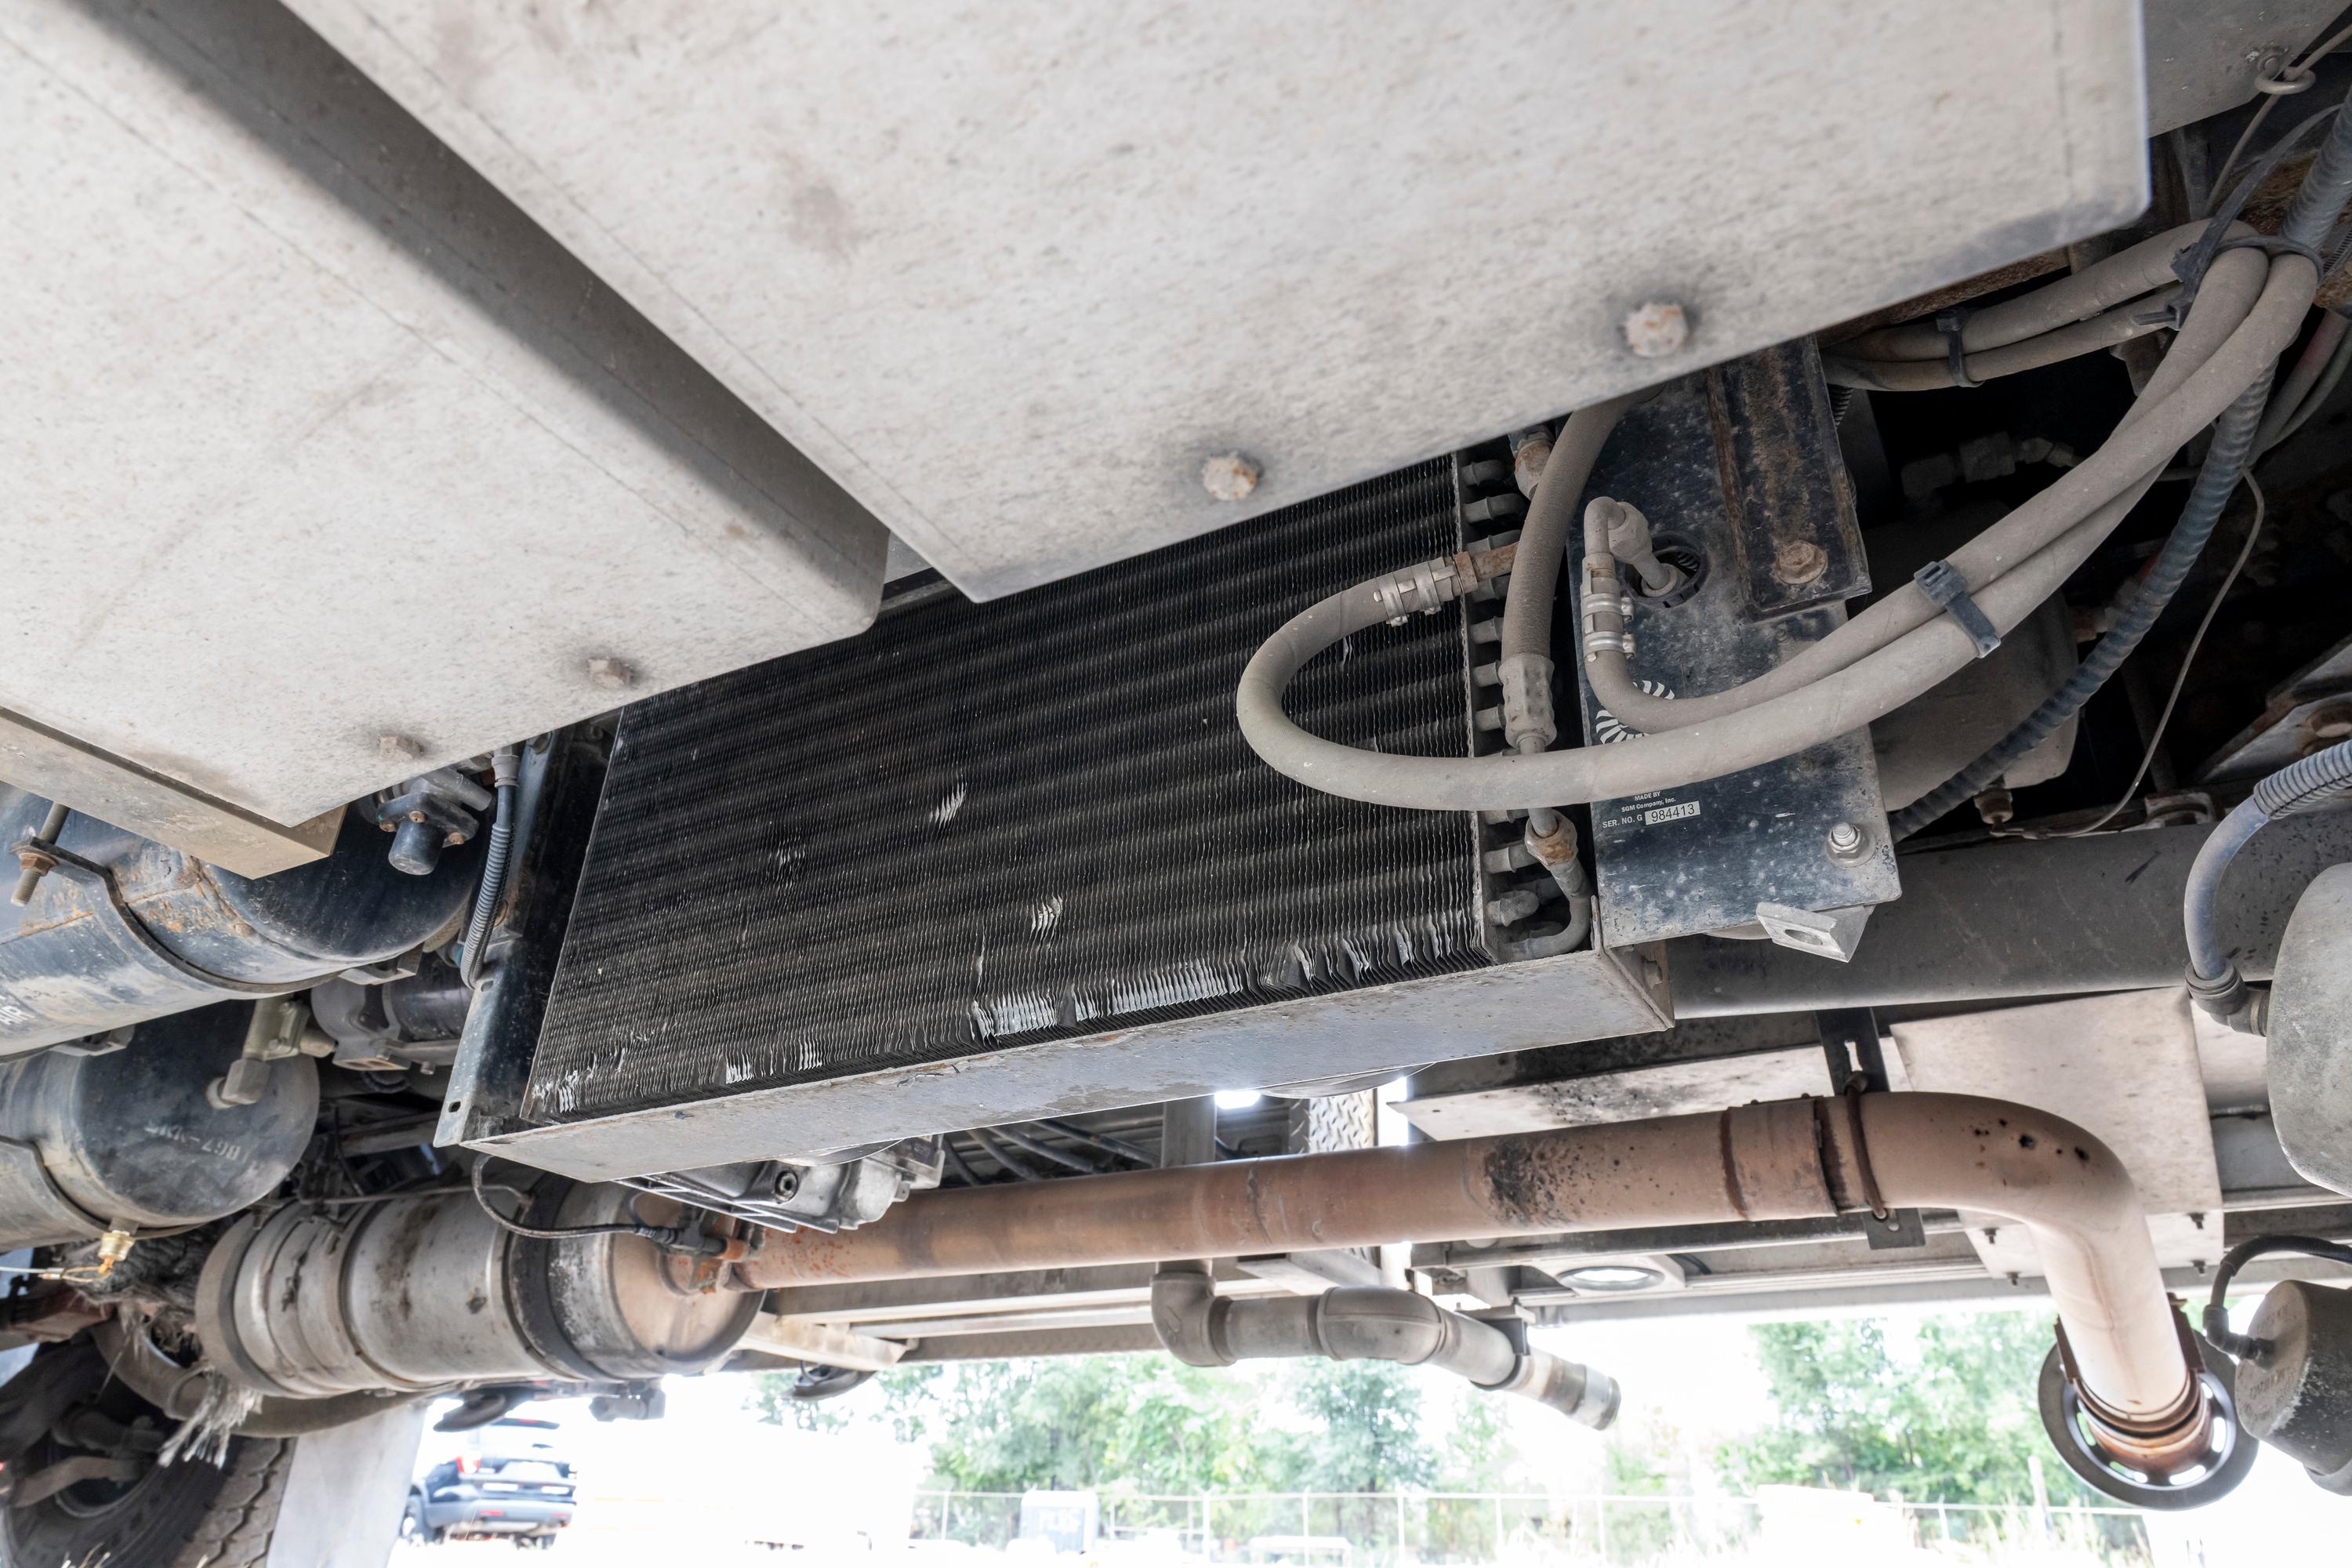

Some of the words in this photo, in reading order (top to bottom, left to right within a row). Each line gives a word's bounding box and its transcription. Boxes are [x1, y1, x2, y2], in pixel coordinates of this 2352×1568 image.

[1635, 793, 1652, 801] MADE
[1636, 800, 1664, 808] Company,
[1602, 819, 1620, 829] SER.
[1621, 816, 1635, 825] NO.
[1651, 804, 1695, 822] 984413
